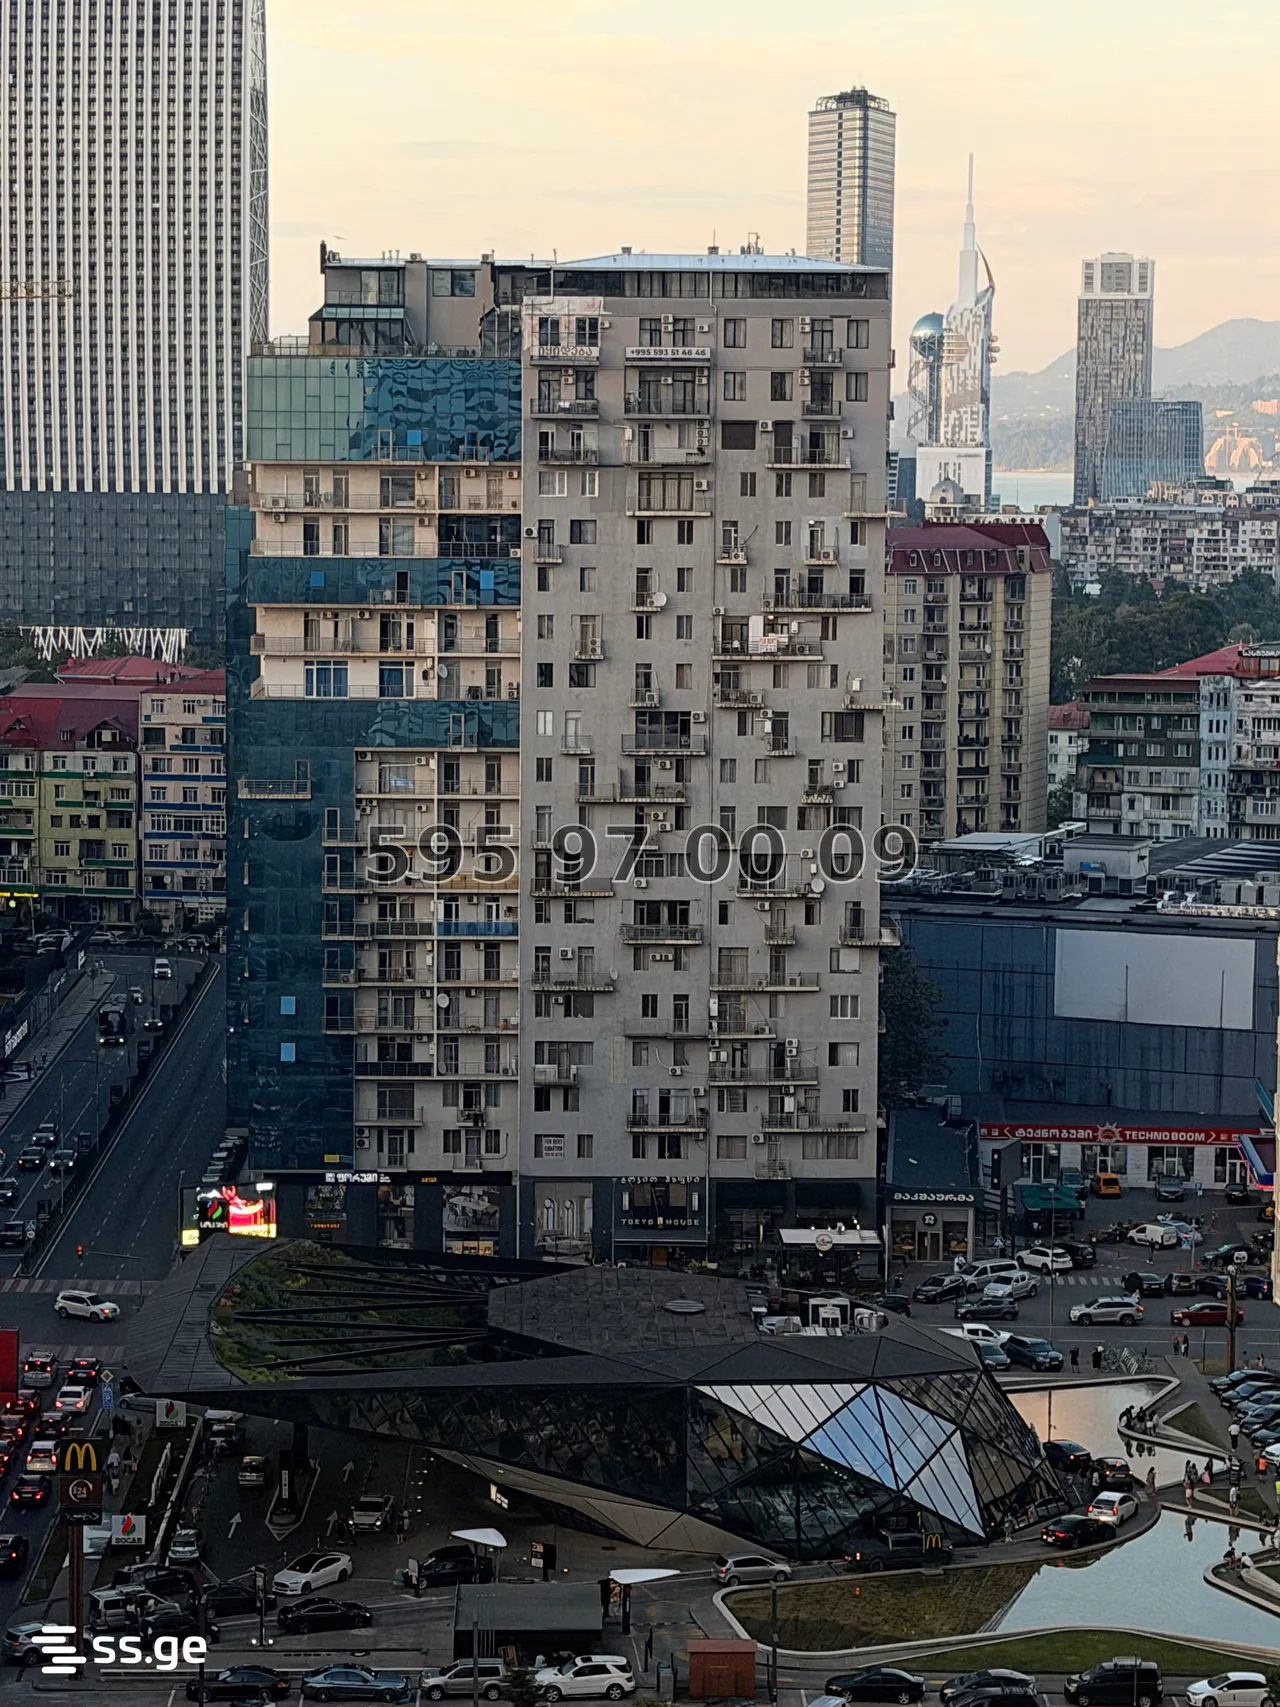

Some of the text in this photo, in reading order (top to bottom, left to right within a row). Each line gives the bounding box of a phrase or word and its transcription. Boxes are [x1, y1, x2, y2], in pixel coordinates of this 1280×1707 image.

[538, 346, 593, 357] იყიდება
[630, 348, 707, 357] +995 593 51 46 46
[1015, 1128, 1093, 1140] ტექნო ბუმი
[1125, 1130, 1206, 1142] TECHNO BOOM
[336, 1173, 378, 1183] ფორუმი
[893, 1192, 975, 1202] მაკშაურმა
[621, 1218, 700, 1226] TOKYO HOUSE
